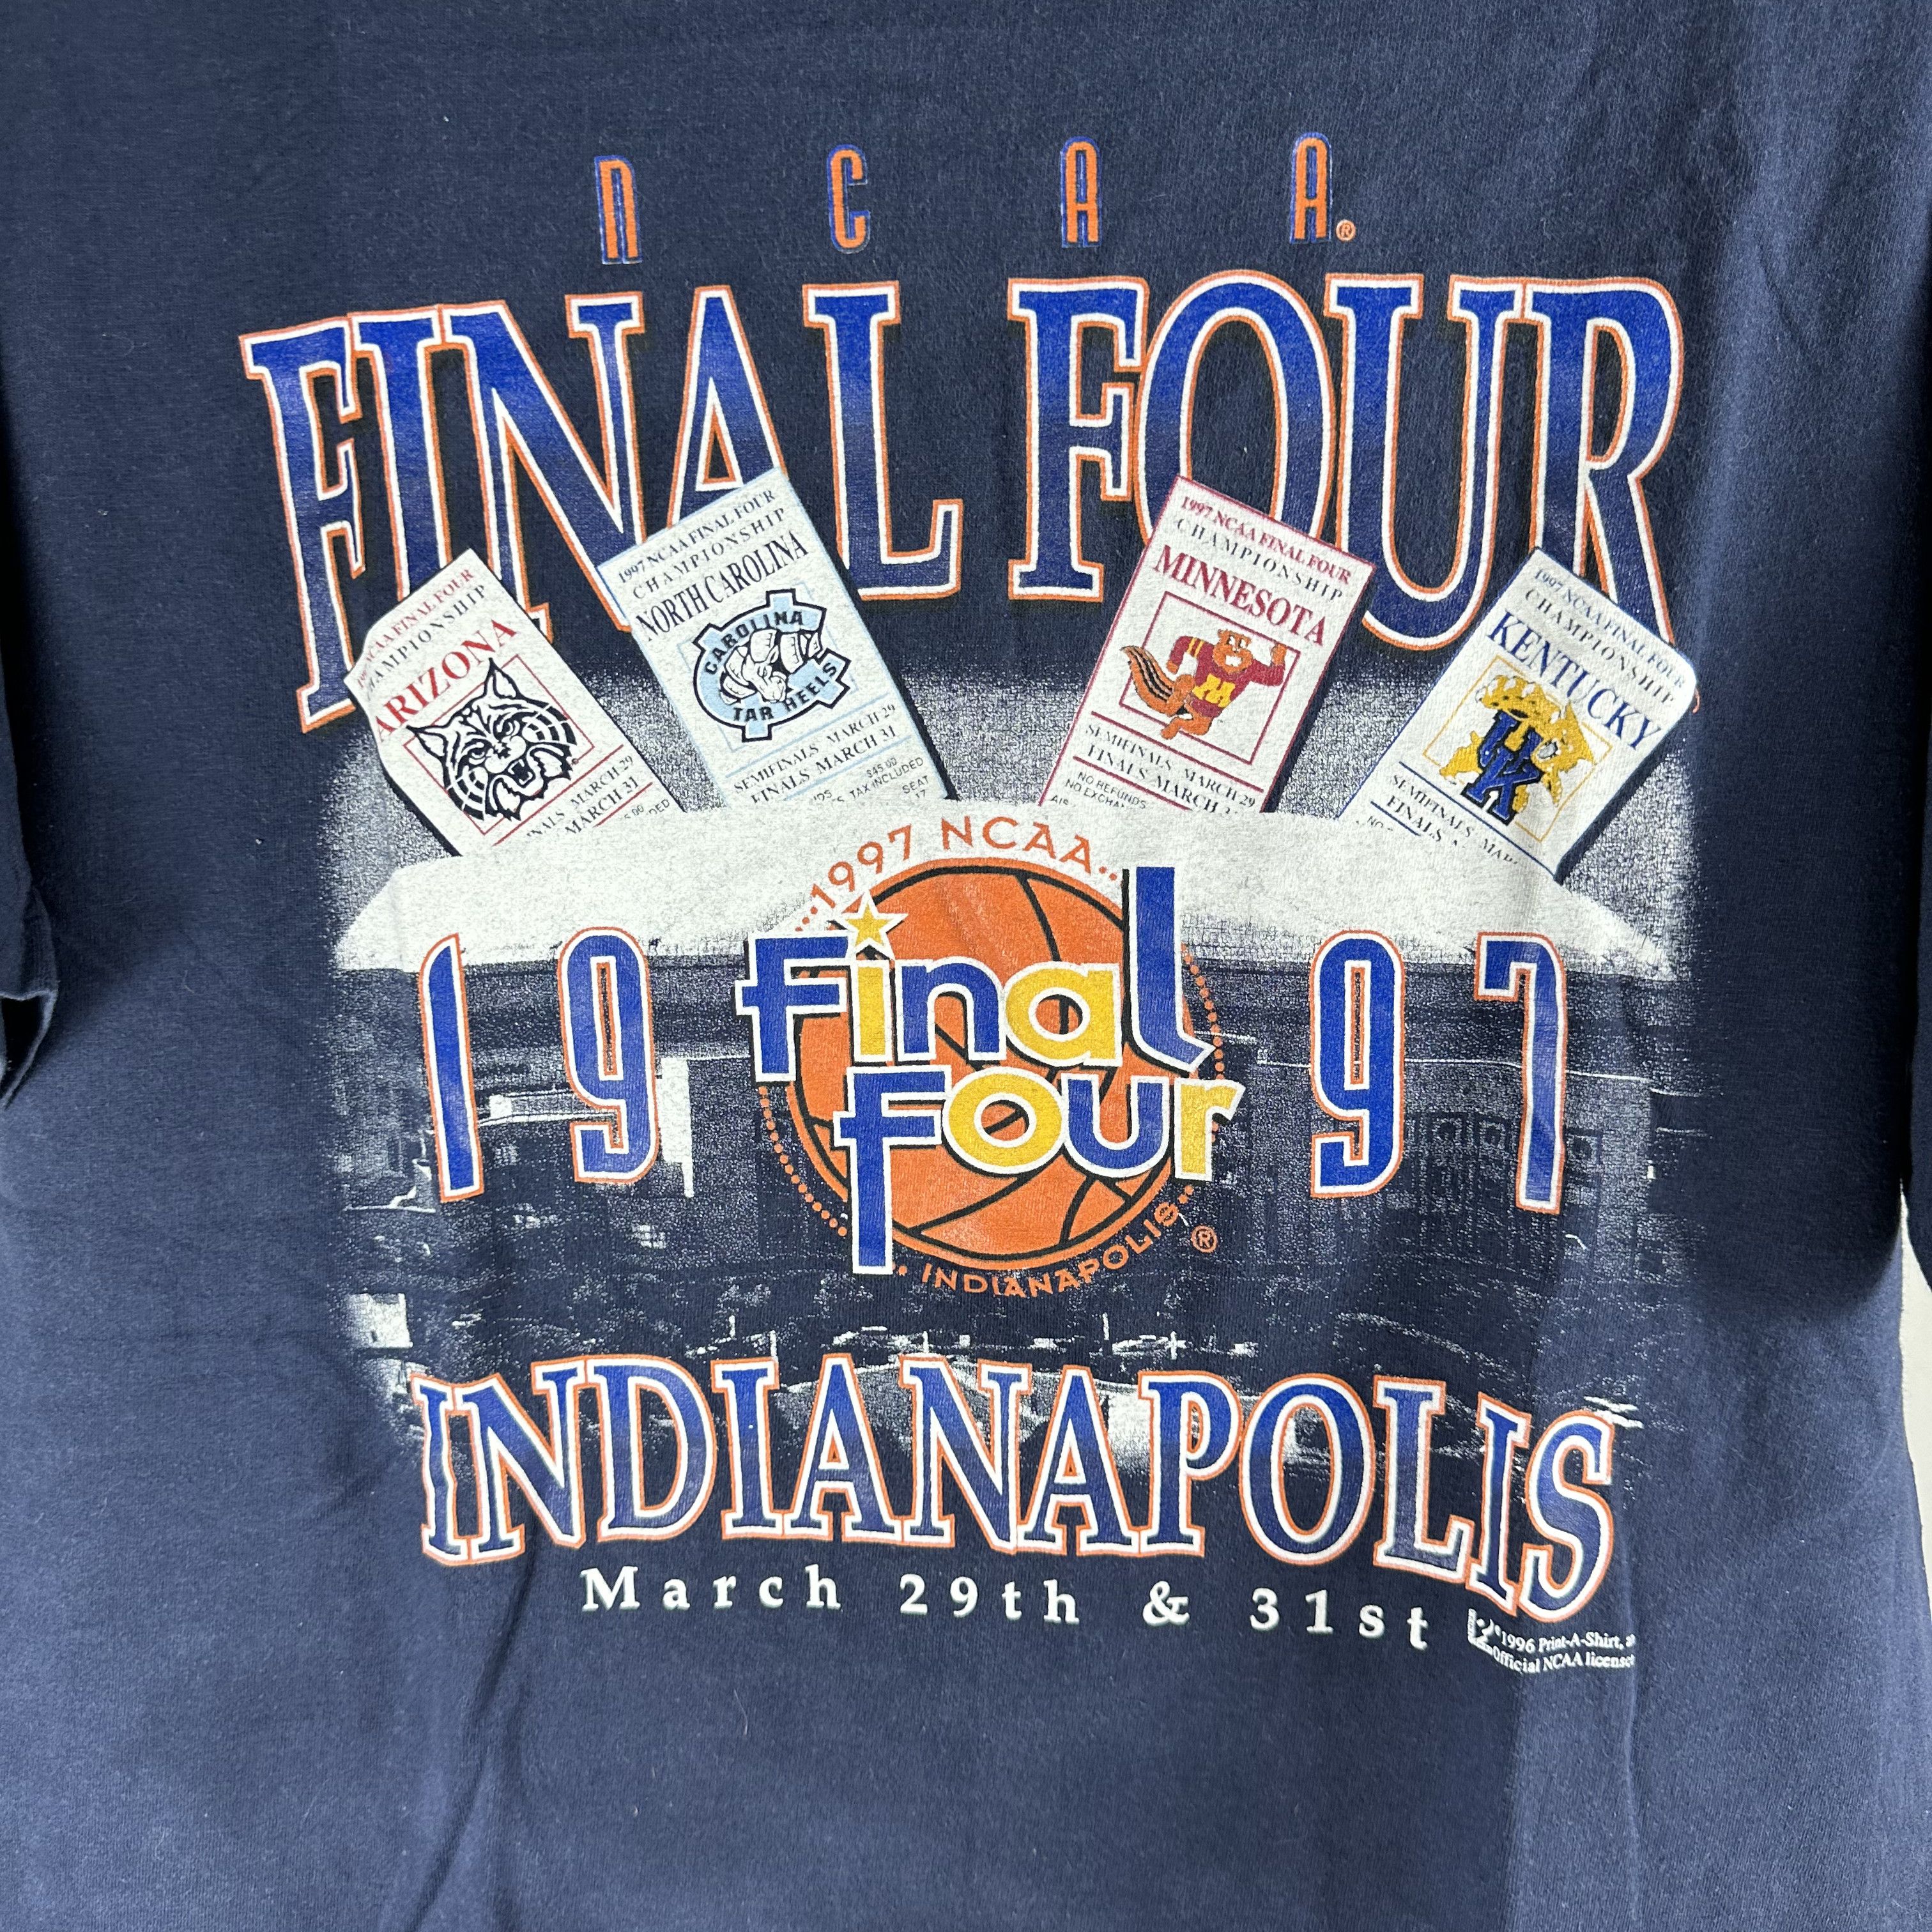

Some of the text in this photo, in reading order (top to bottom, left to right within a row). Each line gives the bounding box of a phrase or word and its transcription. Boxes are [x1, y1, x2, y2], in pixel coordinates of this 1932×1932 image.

[238, 270, 1683, 733] FINAL FOUR
[618, 489, 776, 584] 1997 NCAA FINAL FOUR
[1181, 496, 1351, 585] 1997 NCAA FINAL FOUR
[632, 507, 785, 599] CHAMPIONSHIP
[636, 530, 809, 641] NORTH CAROLINA
[1153, 544, 1326, 647] MINNESOTA
[1177, 518, 1343, 601] CHAMPIONSHIP
[391, 601, 436, 636] FINAL
[433, 569, 475, 604] FOUR
[705, 610, 804, 675] CAROLINA
[1525, 587, 1675, 704] CHAMPIONSHIP
[1534, 569, 1685, 689] 1997 NCAA FINAL FOUR
[376, 619, 518, 742] ARIZONA
[733, 662, 838, 722] TAR HEELS
[1487, 609, 1662, 751] KENTUCKY
[571, 766, 620, 809] MARCH
[619, 755, 634, 770] 29
[734, 703, 896, 793] SEMIFINALS MARCH 29
[751, 724, 897, 803] FINALS MARCH 31
[850, 783, 871, 799] TAX
[871, 756, 924, 788] INCLUDED
[901, 775, 930, 794] SEAT
[1065, 778, 1082, 792] NO
[1077, 771, 1147, 809] NO REFUNDS
[1085, 724, 1256, 808] SEMIFINALS MARCH 29
[1087, 744, 1219, 814] FINALS MARCH
[565, 788, 623, 834] MARCH
[622, 776, 639, 793] 31
[1386, 795, 1442, 842] FINALS
[1392, 774, 1517, 864] SEMIFINALS MAR
[809, 816, 1094, 903] 1997 NCAA
[921, 1200, 1181, 1300] INDIANAPOLIS
[409, 1353, 1615, 1623] INDIANAPOLIS
[580, 1563, 842, 1613] March
[899, 1572, 1080, 1626] 29th
[1142, 1579, 1190, 1627] &
[1250, 1588, 1429, 1651] 31st
[1492, 1645, 1541, 1674] Official
[1542, 1652, 1584, 1671] NCAA
